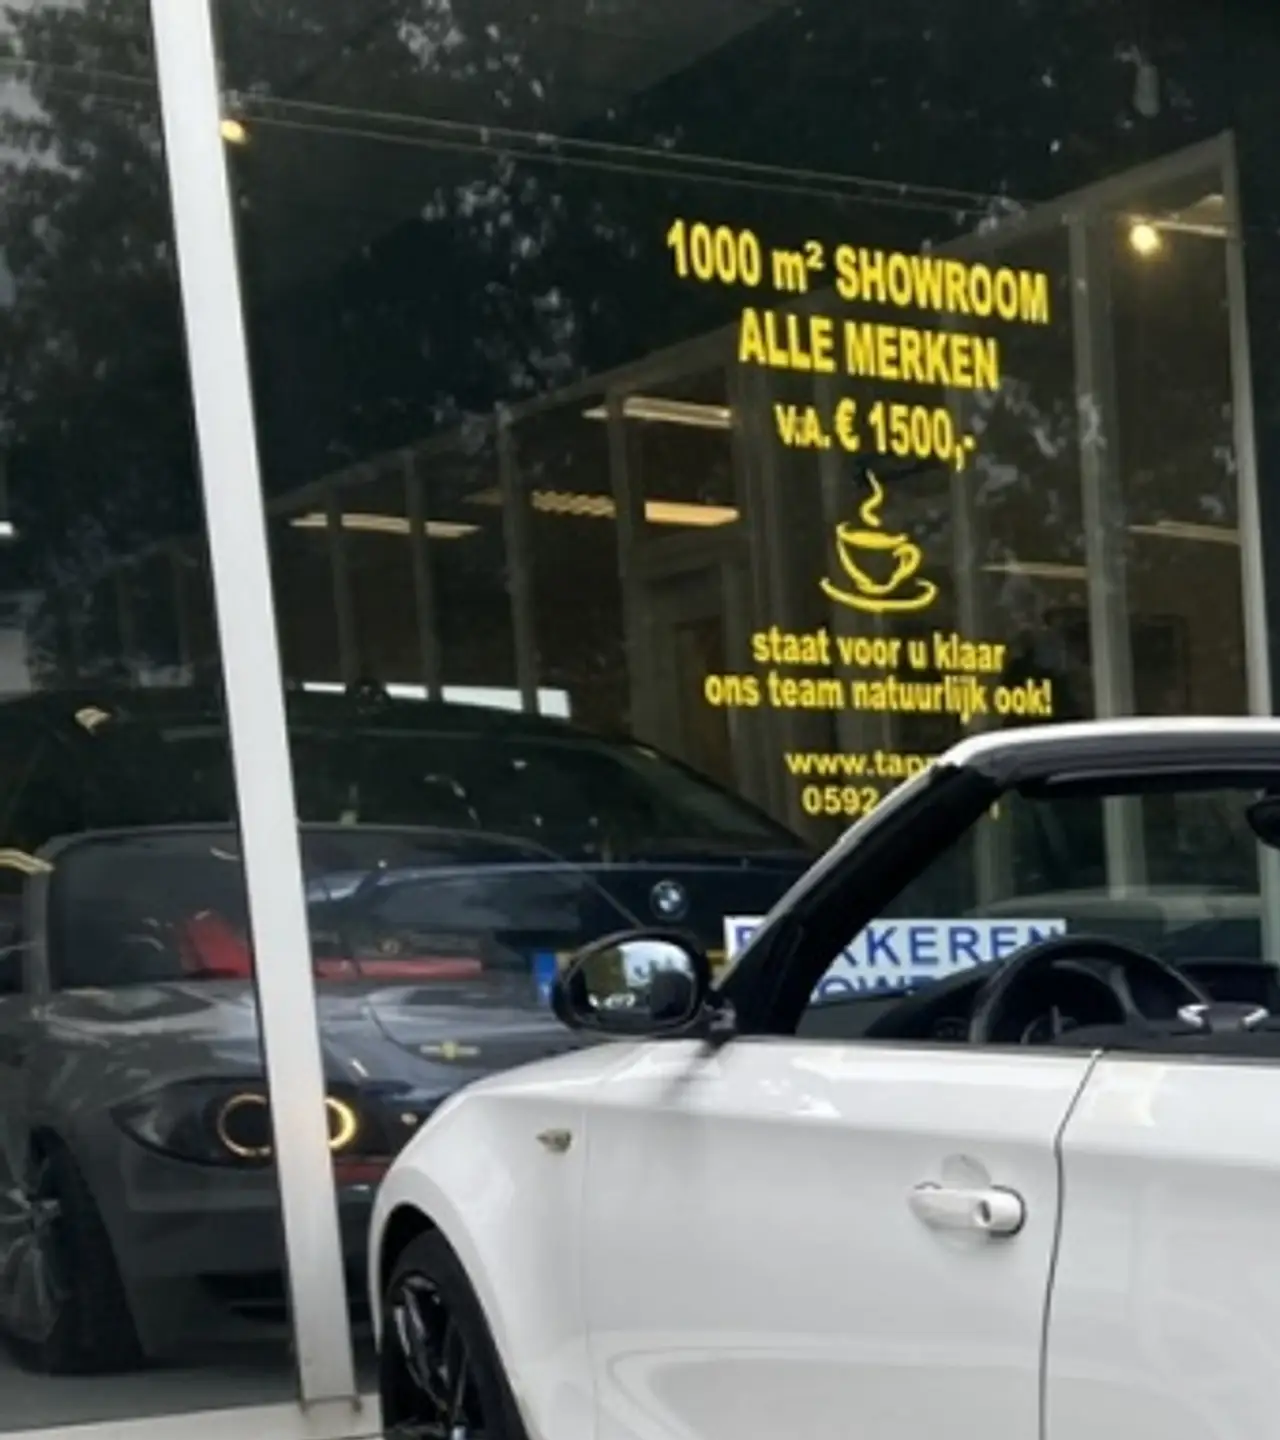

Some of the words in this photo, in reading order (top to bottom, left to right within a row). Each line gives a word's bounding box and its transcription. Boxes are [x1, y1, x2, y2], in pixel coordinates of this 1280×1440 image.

[667, 219, 761, 287] 1000
[772, 241, 824, 292] m²
[835, 244, 1050, 324] SHOWROOM
[738, 307, 837, 374] ALLE
[845, 320, 999, 390] MERKEN
[834, 397, 861, 453] €
[868, 401, 977, 472] 1500,-
[751, 626, 830, 666] staat
[836, 635, 902, 667] voor
[907, 640, 928, 669] u
[932, 632, 1007, 672] klaar
[703, 674, 762, 708] ons
[767, 670, 846, 710] team
[851, 675, 990, 725] natuurlijk
[994, 678, 1054, 716] ook!
[802, 785, 879, 816] 0592
